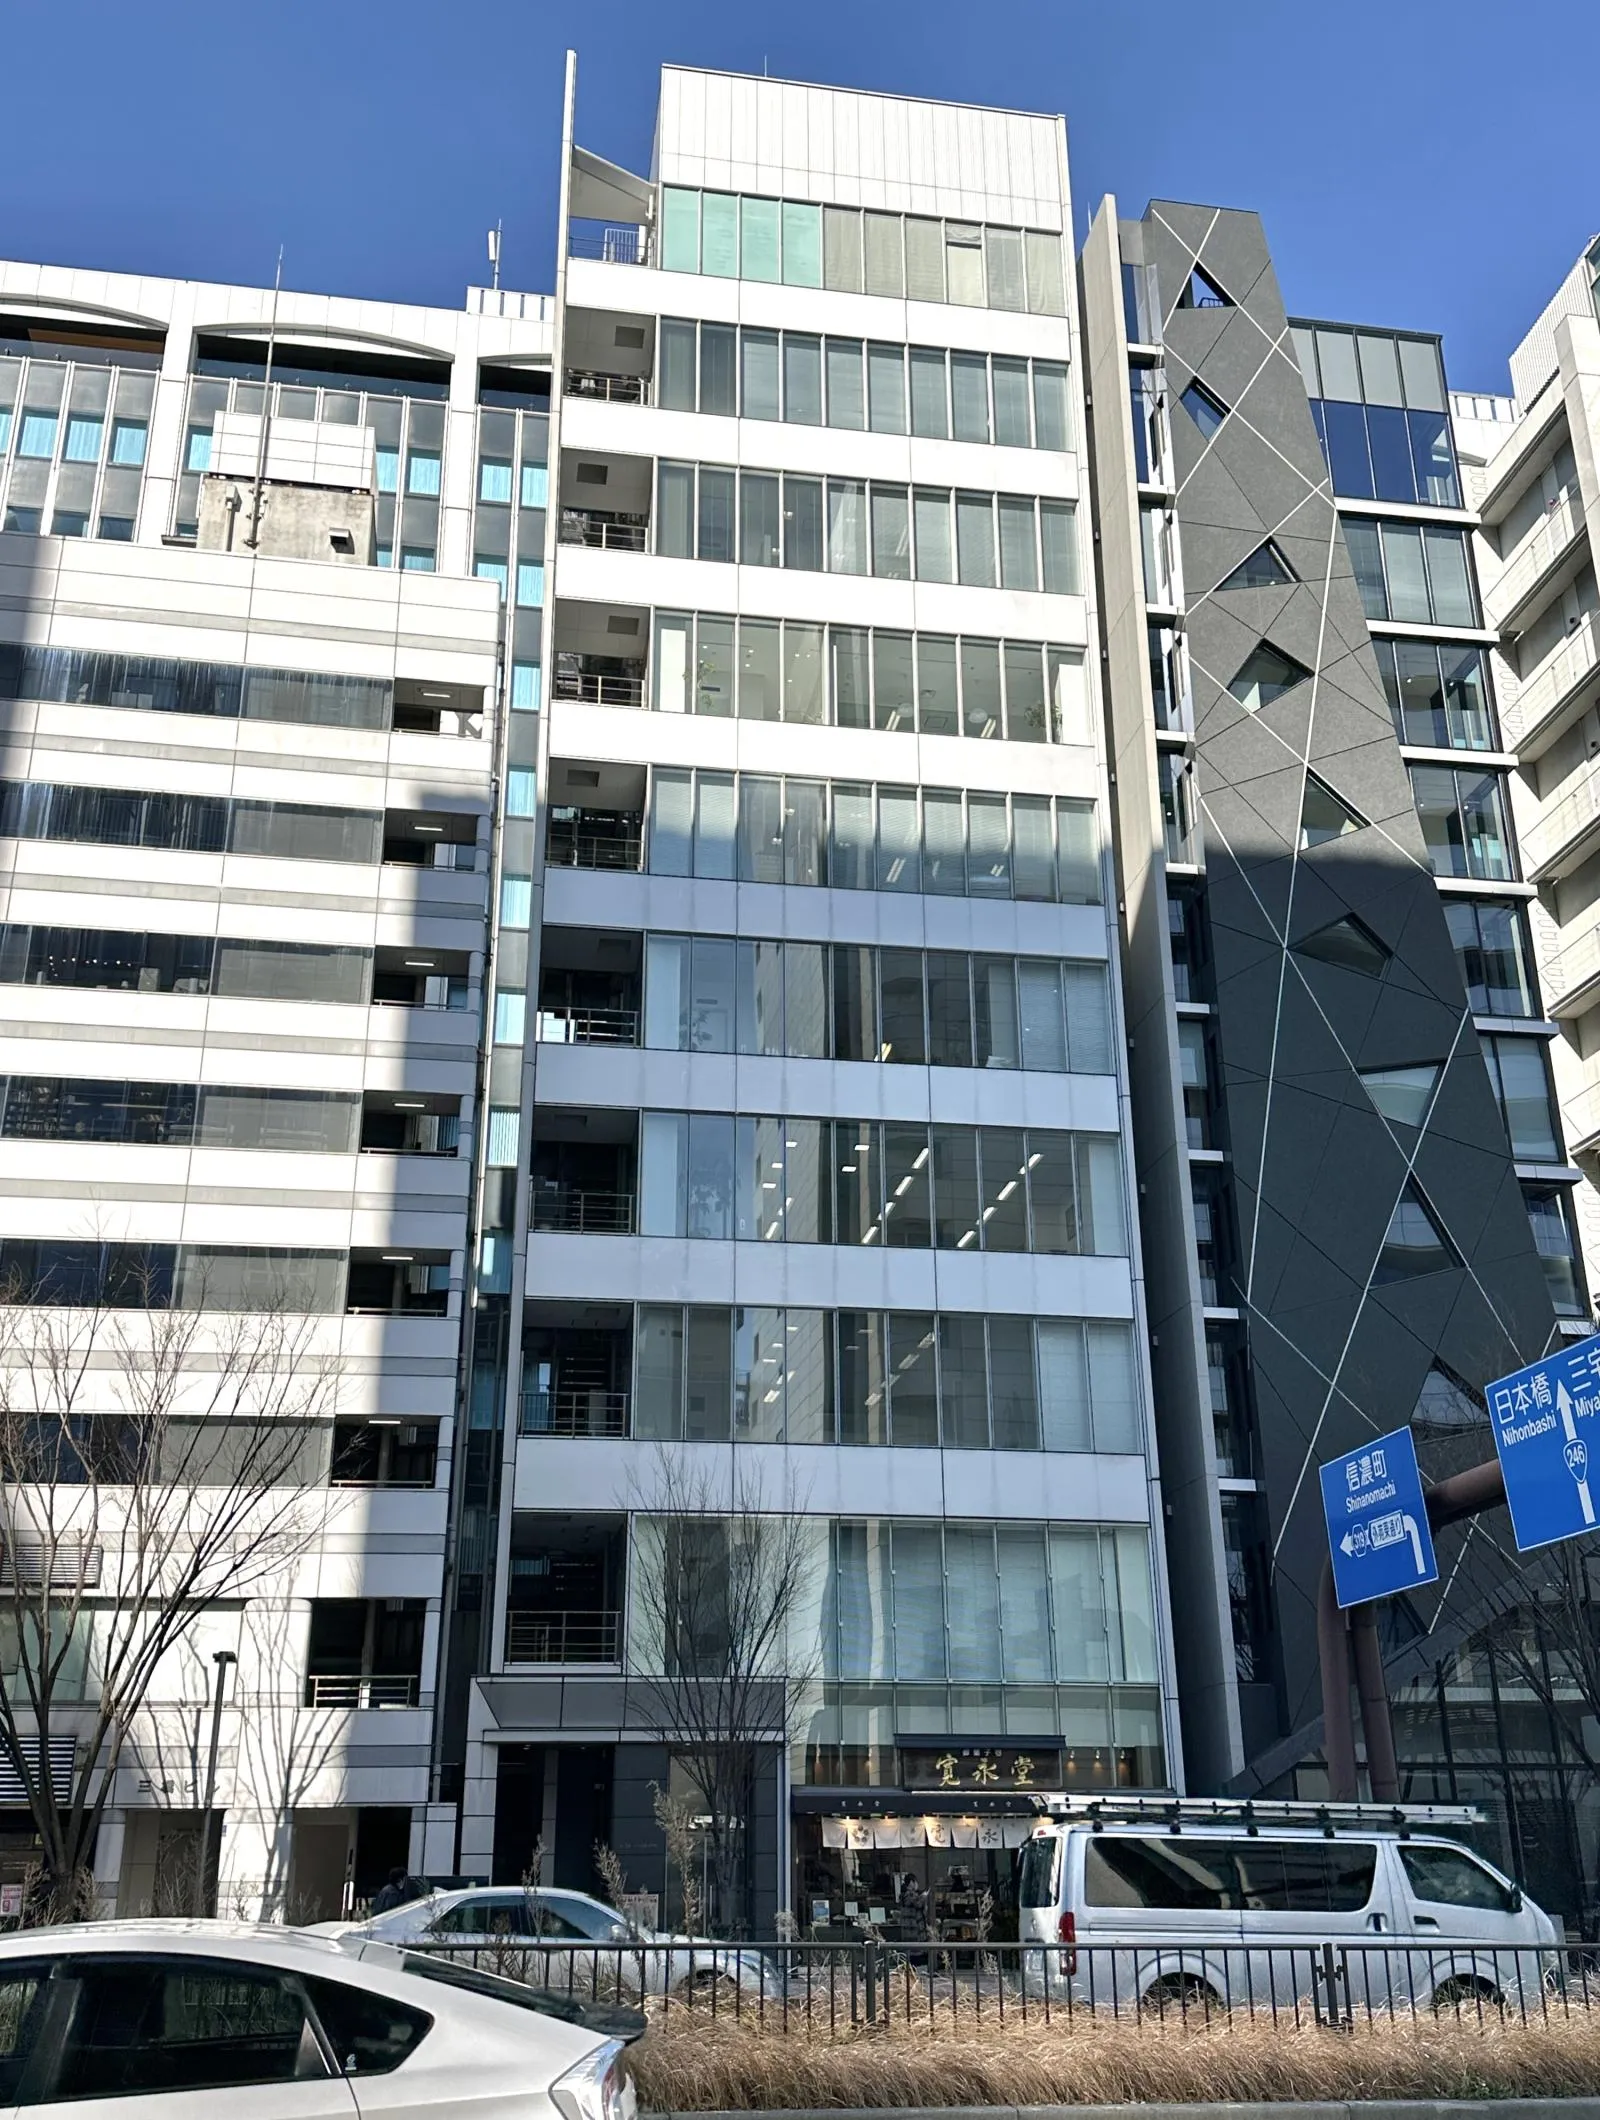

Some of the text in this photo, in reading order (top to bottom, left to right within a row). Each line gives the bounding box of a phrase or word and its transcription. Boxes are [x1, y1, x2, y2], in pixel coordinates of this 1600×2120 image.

[1494, 1372, 1552, 1424] 日本橋
[1574, 1388, 1600, 1419] Miya
[1502, 1410, 1557, 1448] Nihonbashi
[1346, 1449, 1387, 1492] 信濃町
[1567, 1445, 1585, 1468] 246
[1346, 1480, 1396, 1513] Shinanomachi
